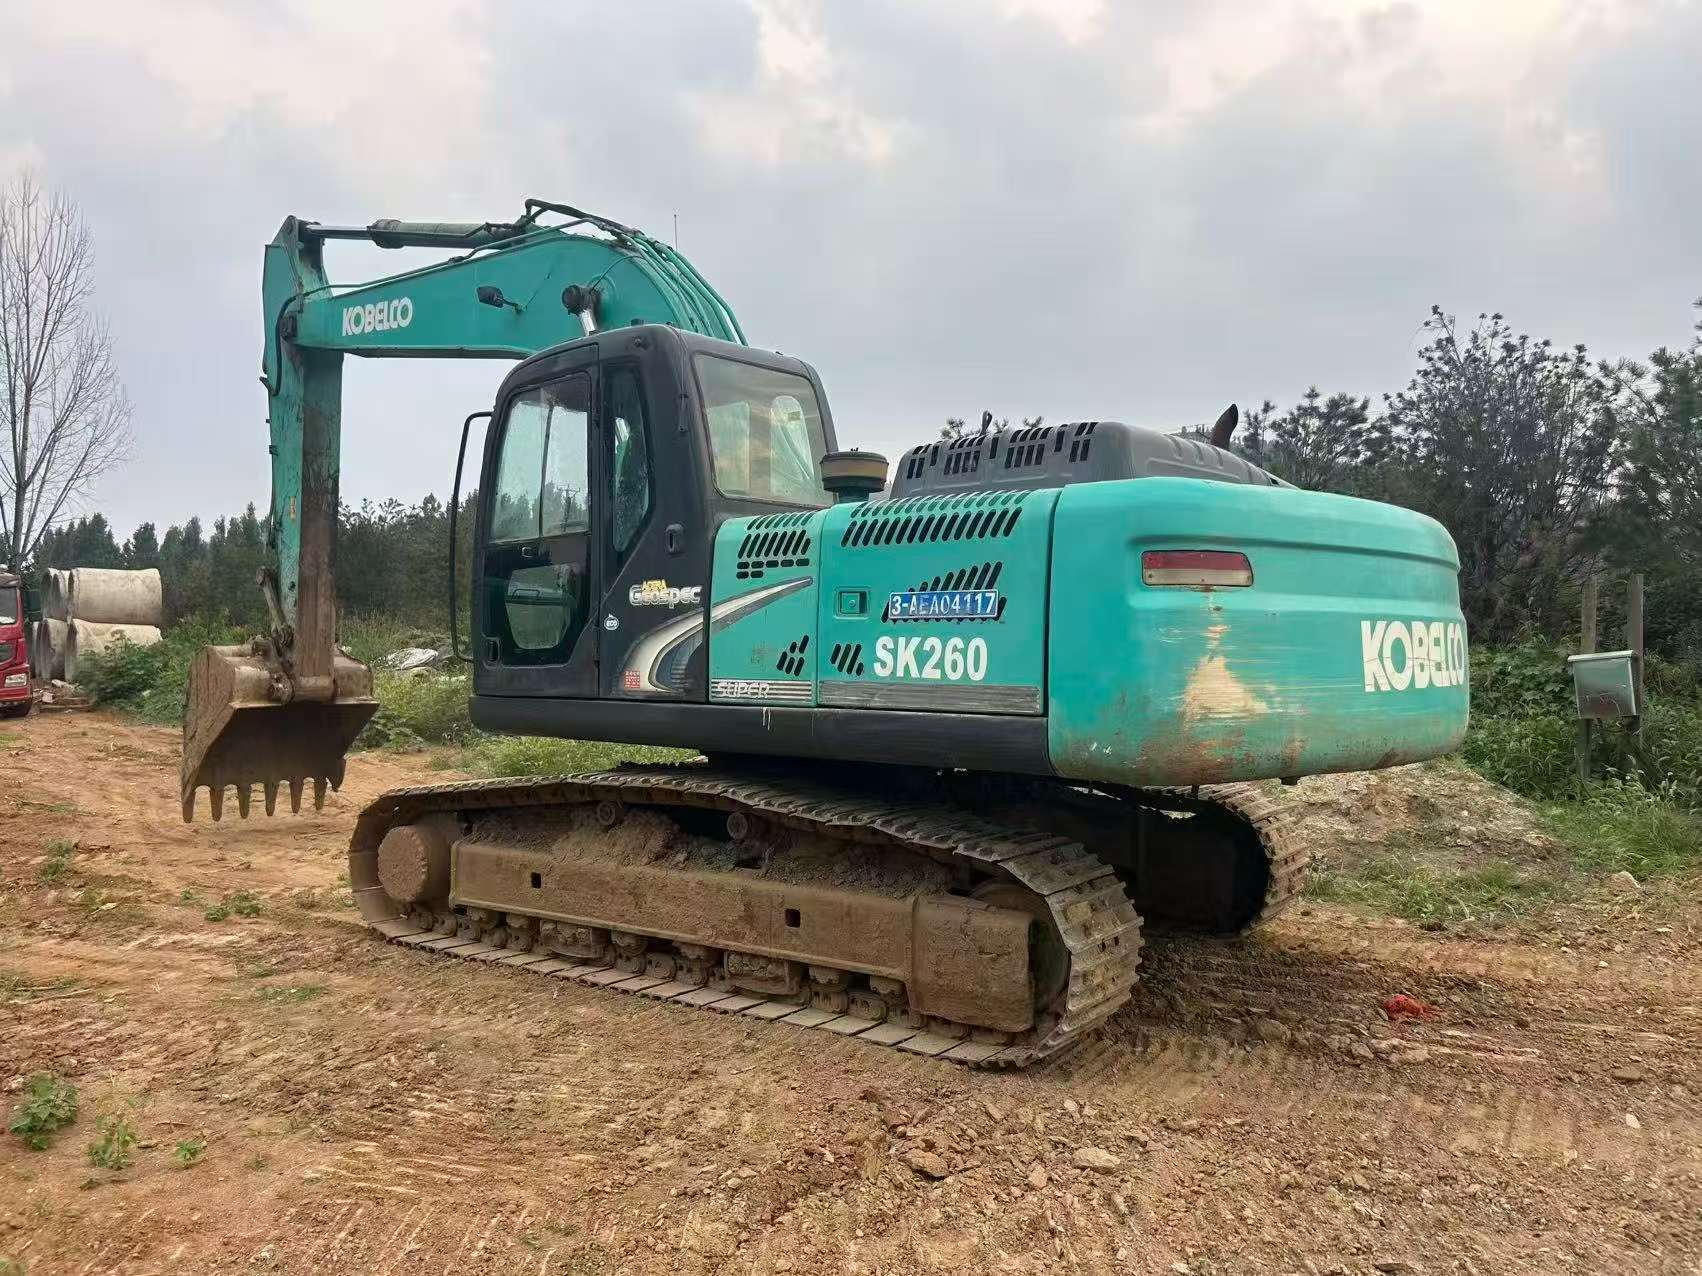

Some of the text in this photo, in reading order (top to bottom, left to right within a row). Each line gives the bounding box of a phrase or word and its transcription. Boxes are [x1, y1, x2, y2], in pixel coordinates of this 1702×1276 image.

[342, 297, 413, 336] KOBELCO
[891, 592, 996, 615] 3-AEA04117
[873, 635, 988, 681] SK260
[1360, 620, 1466, 692] KOBELCO
